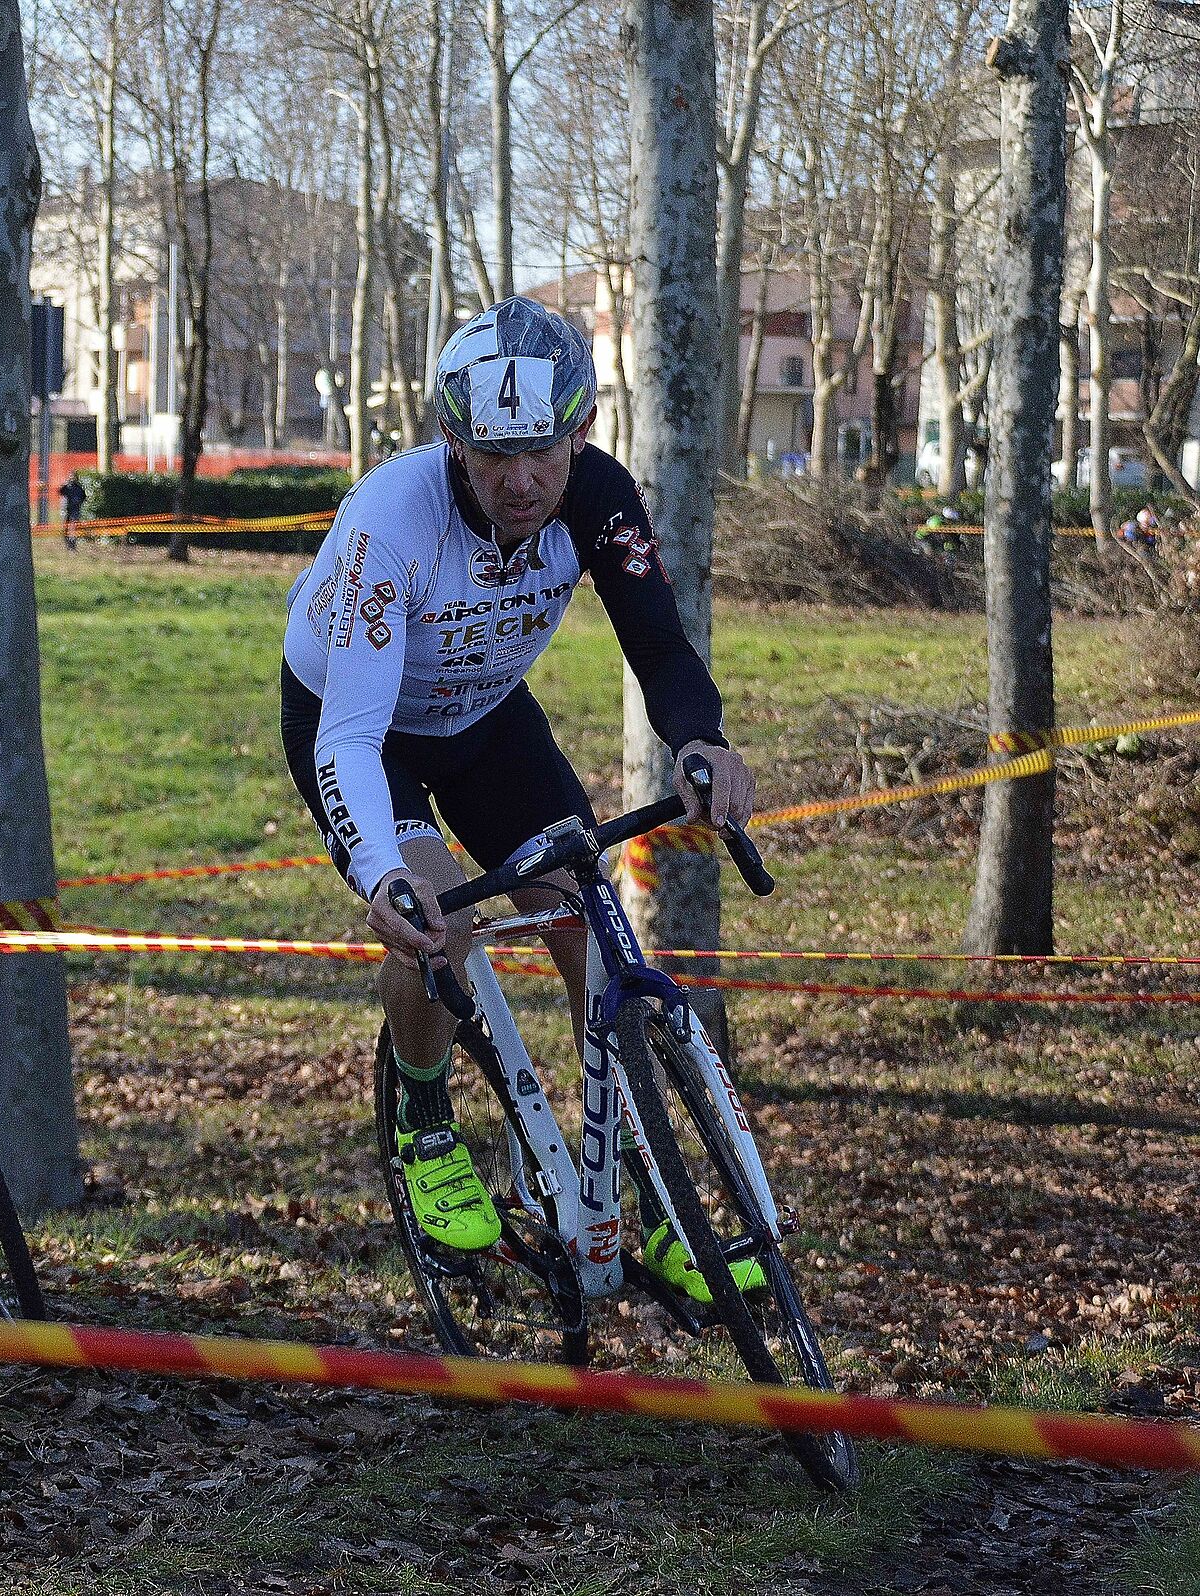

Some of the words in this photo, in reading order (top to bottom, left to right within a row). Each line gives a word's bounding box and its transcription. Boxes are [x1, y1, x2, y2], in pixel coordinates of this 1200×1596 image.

[498, 359, 520, 420] 4
[444, 601, 466, 610] TEAM
[540, 582, 571, 601] 18
[596, 884, 640, 965] FOCUS
